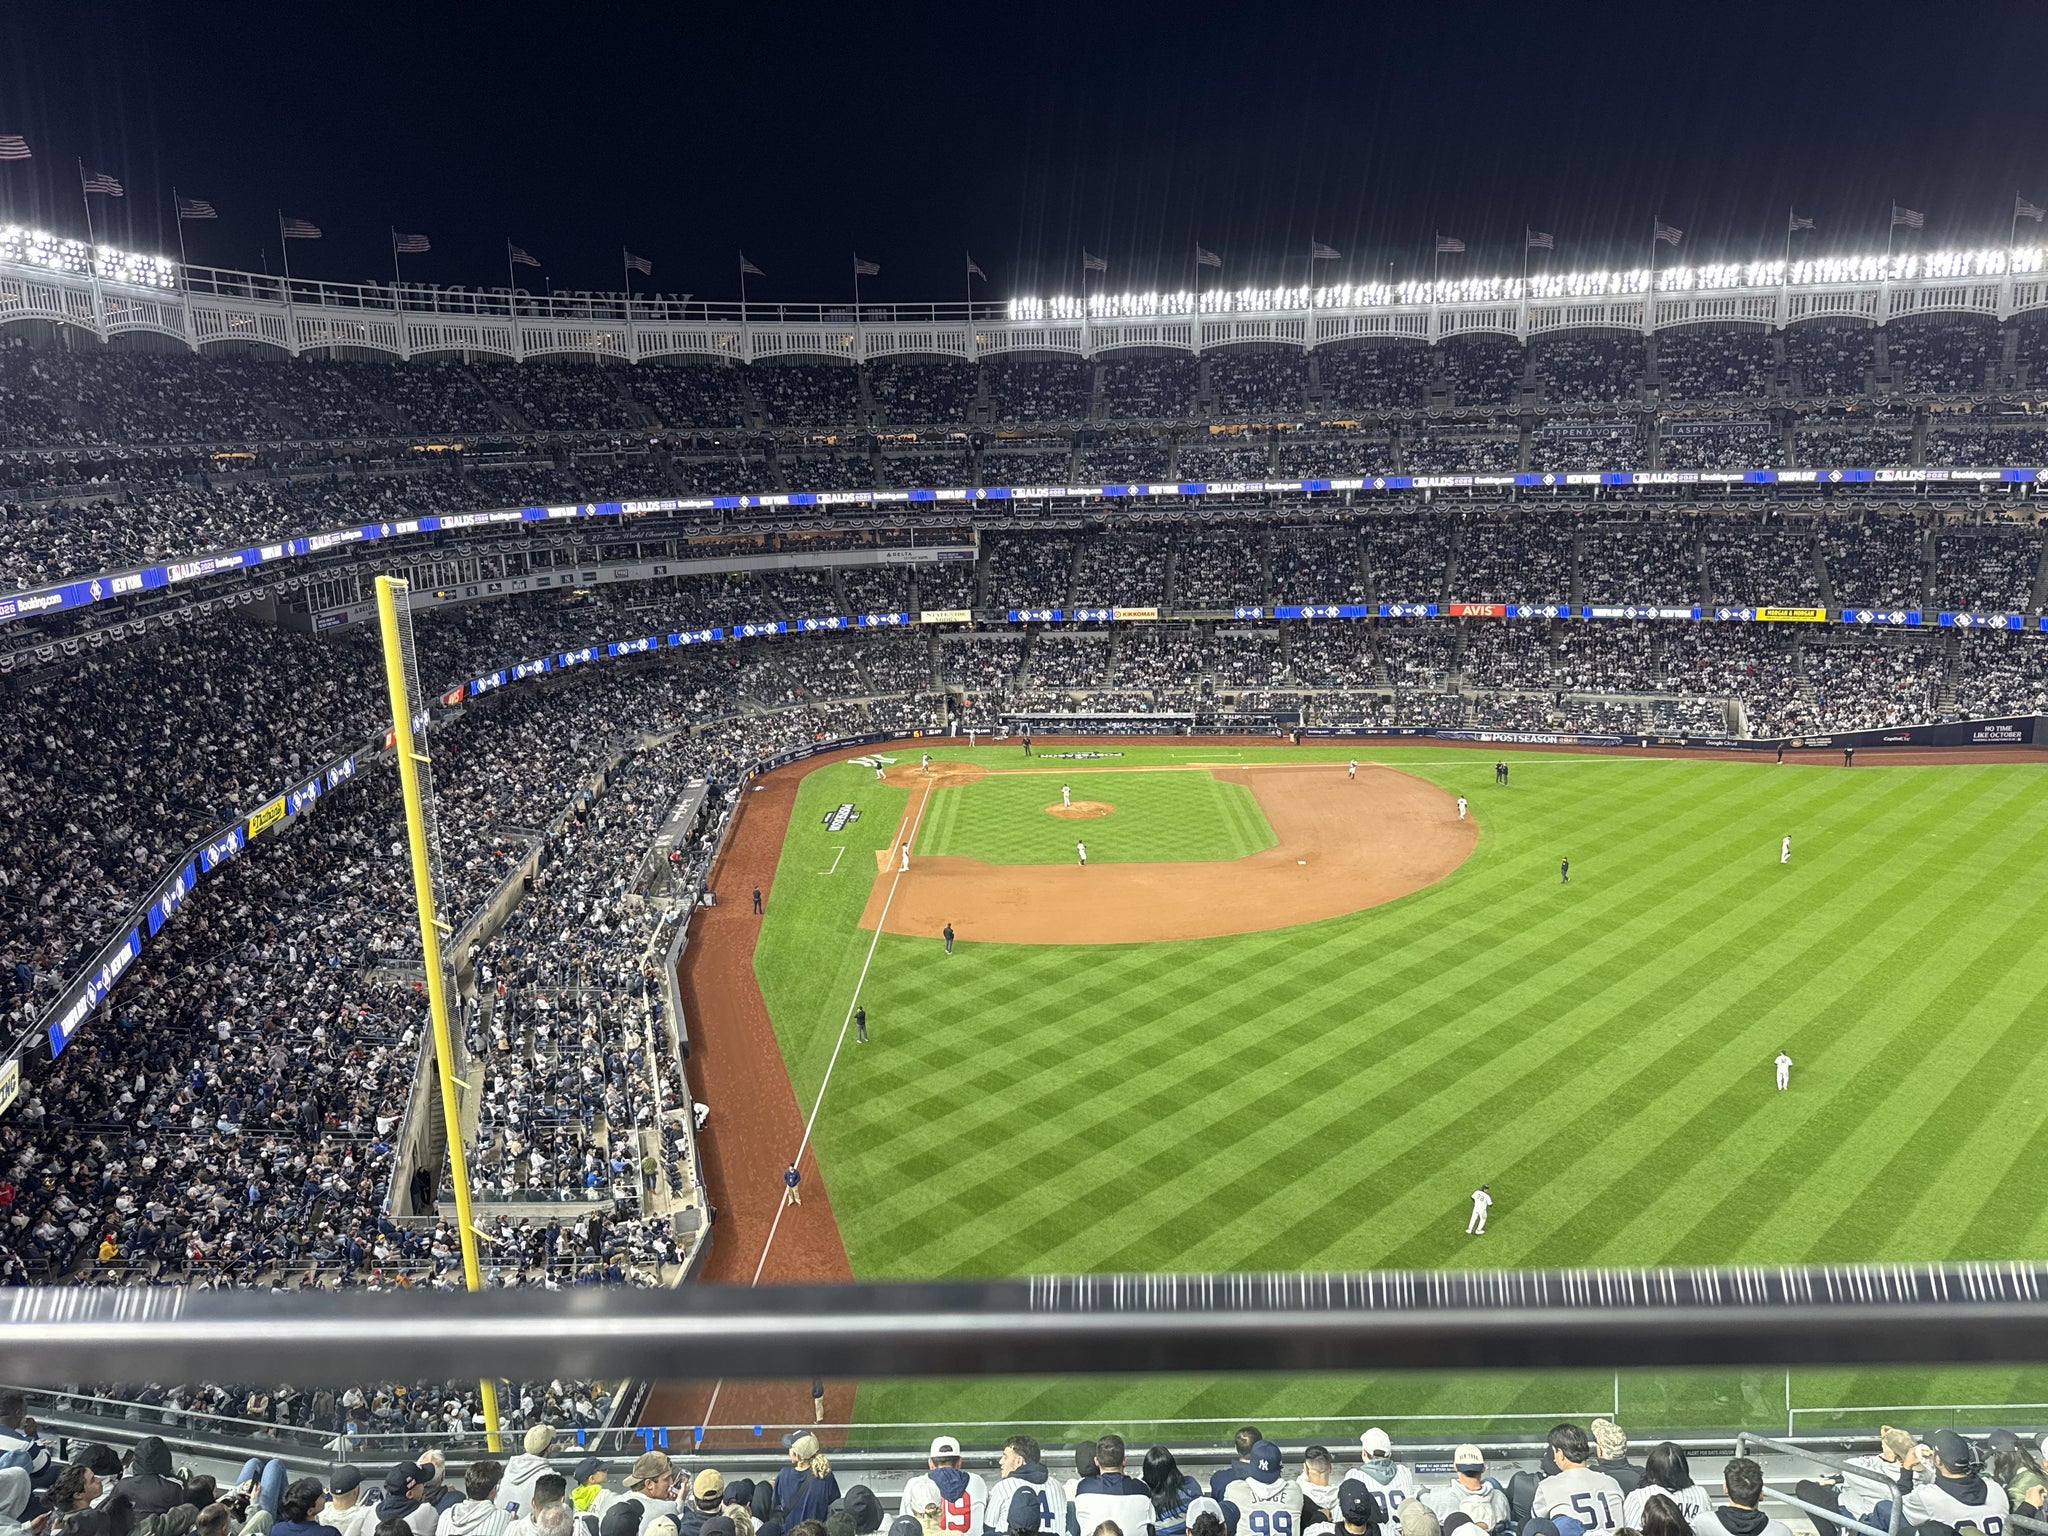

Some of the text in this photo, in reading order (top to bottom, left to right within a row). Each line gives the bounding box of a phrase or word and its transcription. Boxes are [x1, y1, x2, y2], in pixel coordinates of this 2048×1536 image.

[1677, 424, 1764, 435] ASPEN VODKA
[1650, 473, 1678, 483] ALDS
[1778, 471, 1816, 481] TAMPA BAY
[1894, 470, 1926, 480] ALDS
[1951, 470, 2000, 480] Booking.com
[1427, 476, 1454, 486] ALDS
[1220, 482, 1245, 492] ALDS
[831, 493, 855, 502] ALDS
[1025, 488, 1049, 497] ALDS
[635, 502, 660, 512] ALDS
[453, 514, 474, 526] ALDS
[181, 563, 201, 578] ALDS
[18, 594, 62, 612] Booking.com
[1462, 606, 1493, 616] AVIS
[1493, 733, 1557, 744] POSTSEASON
[252, 803, 282, 829] Nathan's
[1570, 1491, 1615, 1531] 51
[1249, 1511, 1293, 1536] 99
